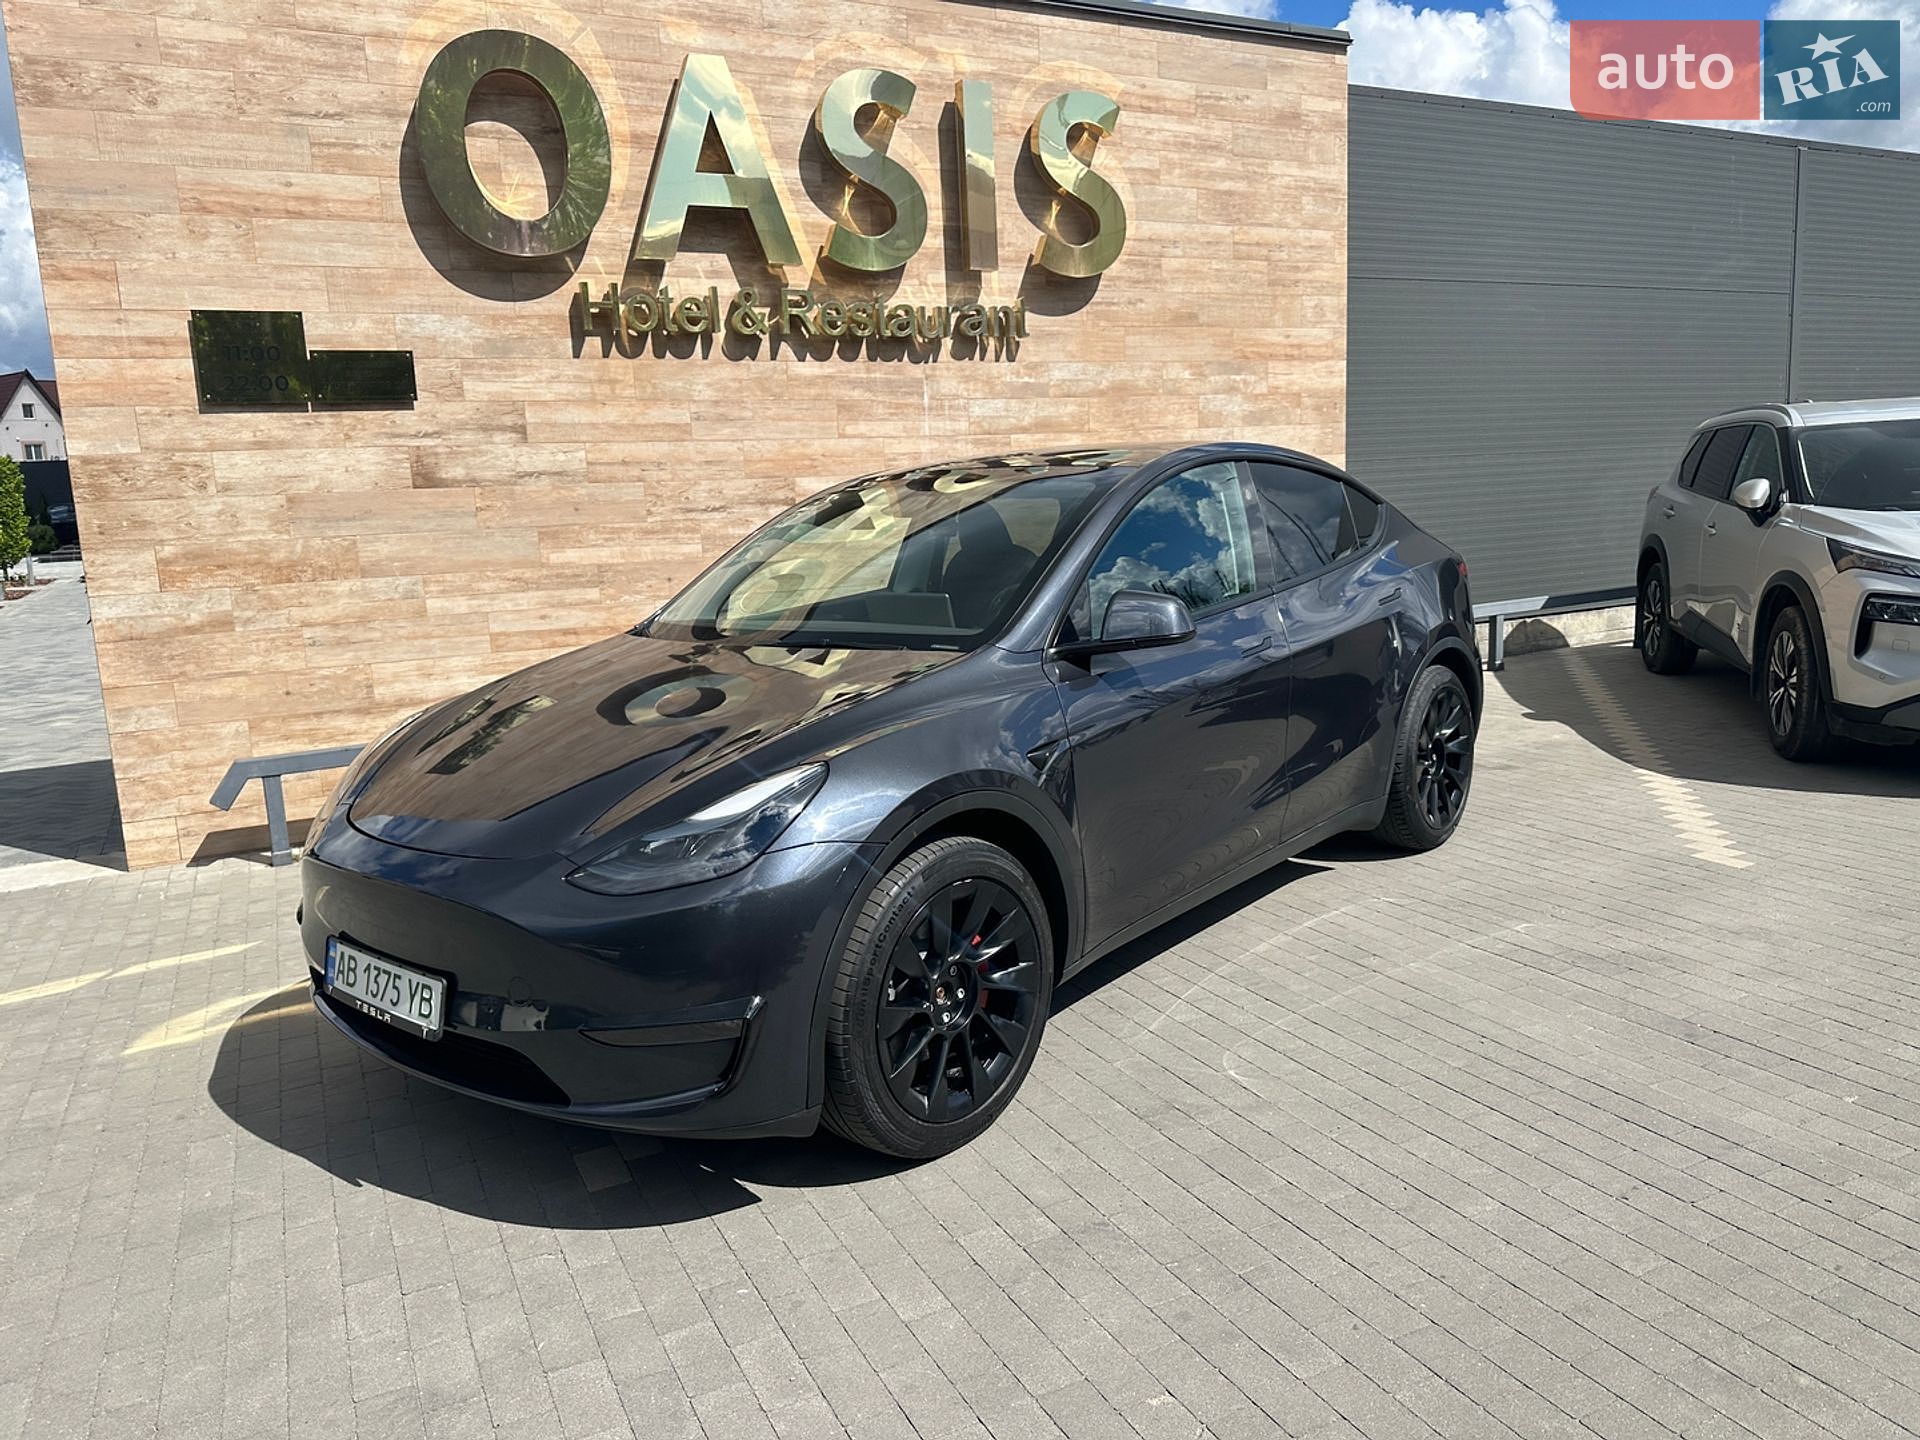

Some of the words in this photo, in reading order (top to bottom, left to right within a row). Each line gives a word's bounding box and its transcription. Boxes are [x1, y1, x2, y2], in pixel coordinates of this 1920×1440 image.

[416, 29, 1127, 278] OASIS
[578, 281, 721, 334] Hotel
[732, 286, 770, 336] &
[781, 287, 1030, 339] Restaurant
[222, 346, 281, 362] 11:00
[223, 375, 289, 392] 22:00
[336, 951, 358, 988] AB
[363, 962, 402, 1007] 1375
[408, 978, 434, 1019] YB
[355, 1000, 392, 1024] TESLA
